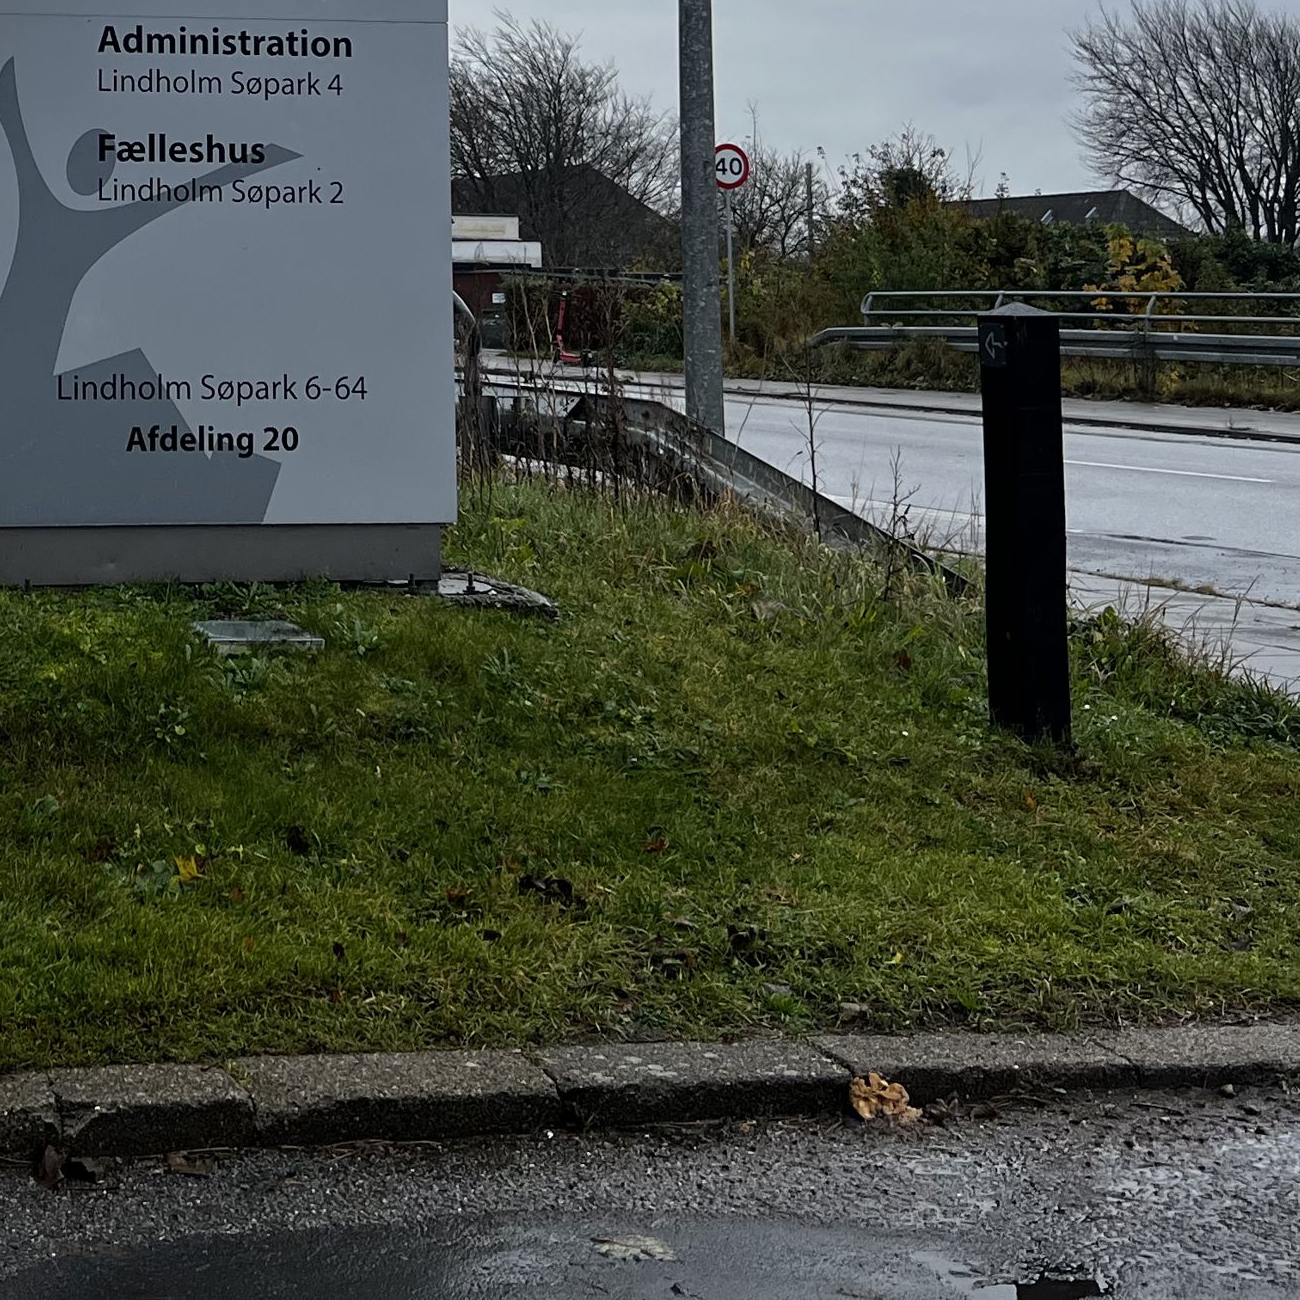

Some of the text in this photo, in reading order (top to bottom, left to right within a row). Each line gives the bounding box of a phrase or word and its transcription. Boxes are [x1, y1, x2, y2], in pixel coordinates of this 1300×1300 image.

[97, 25, 352, 58] Administration
[98, 68, 343, 101] Lindholm Søpark 4
[98, 133, 266, 165] Fælleshus
[715, 157, 742, 175] 40
[98, 178, 344, 210] Lindholm Søpark 2
[57, 373, 368, 407] Lindholm Søpark 6-64
[125, 425, 299, 459] Afdeling 20
